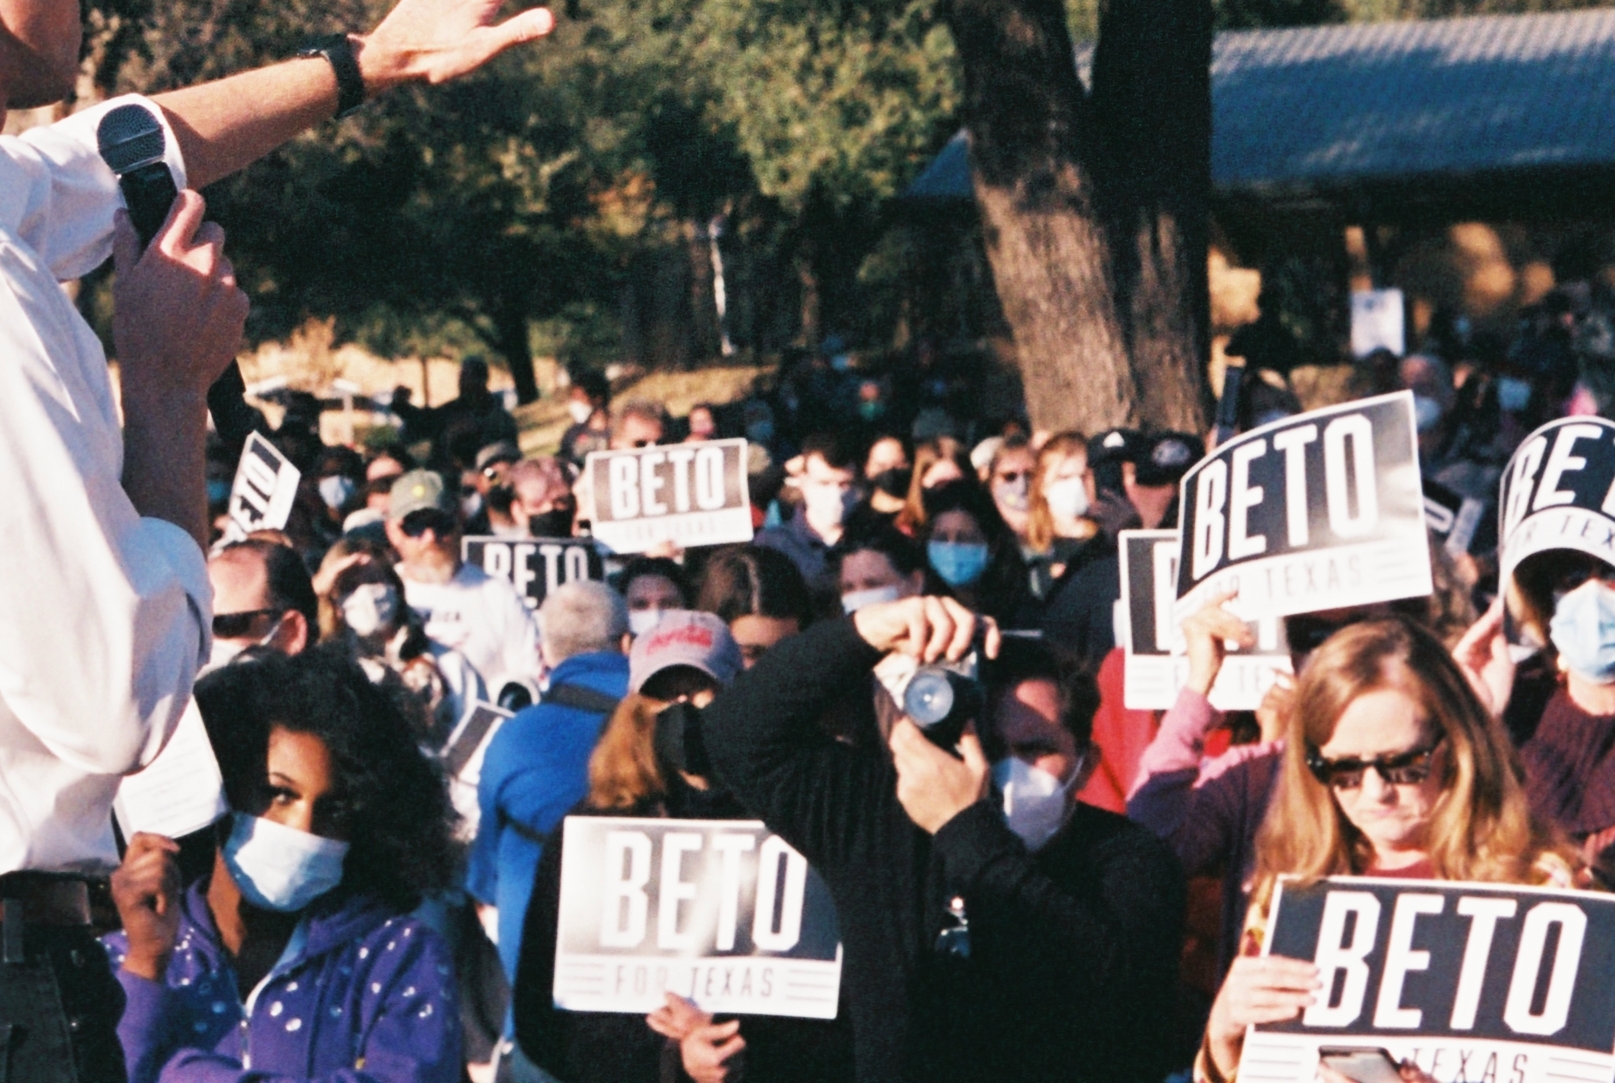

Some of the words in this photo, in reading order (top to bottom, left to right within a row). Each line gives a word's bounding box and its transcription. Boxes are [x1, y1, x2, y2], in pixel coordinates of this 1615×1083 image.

[227, 449, 278, 537] ETO
[609, 446, 726, 520] BETO
[1192, 413, 1378, 582] BETO
[1503, 423, 1615, 541] BE
[1265, 554, 1362, 598] TEXAS
[1559, 514, 1615, 550] TEX
[598, 831, 808, 952] BETO
[690, 966, 774, 998] TEXAS
[1302, 890, 1588, 1037] BETO
